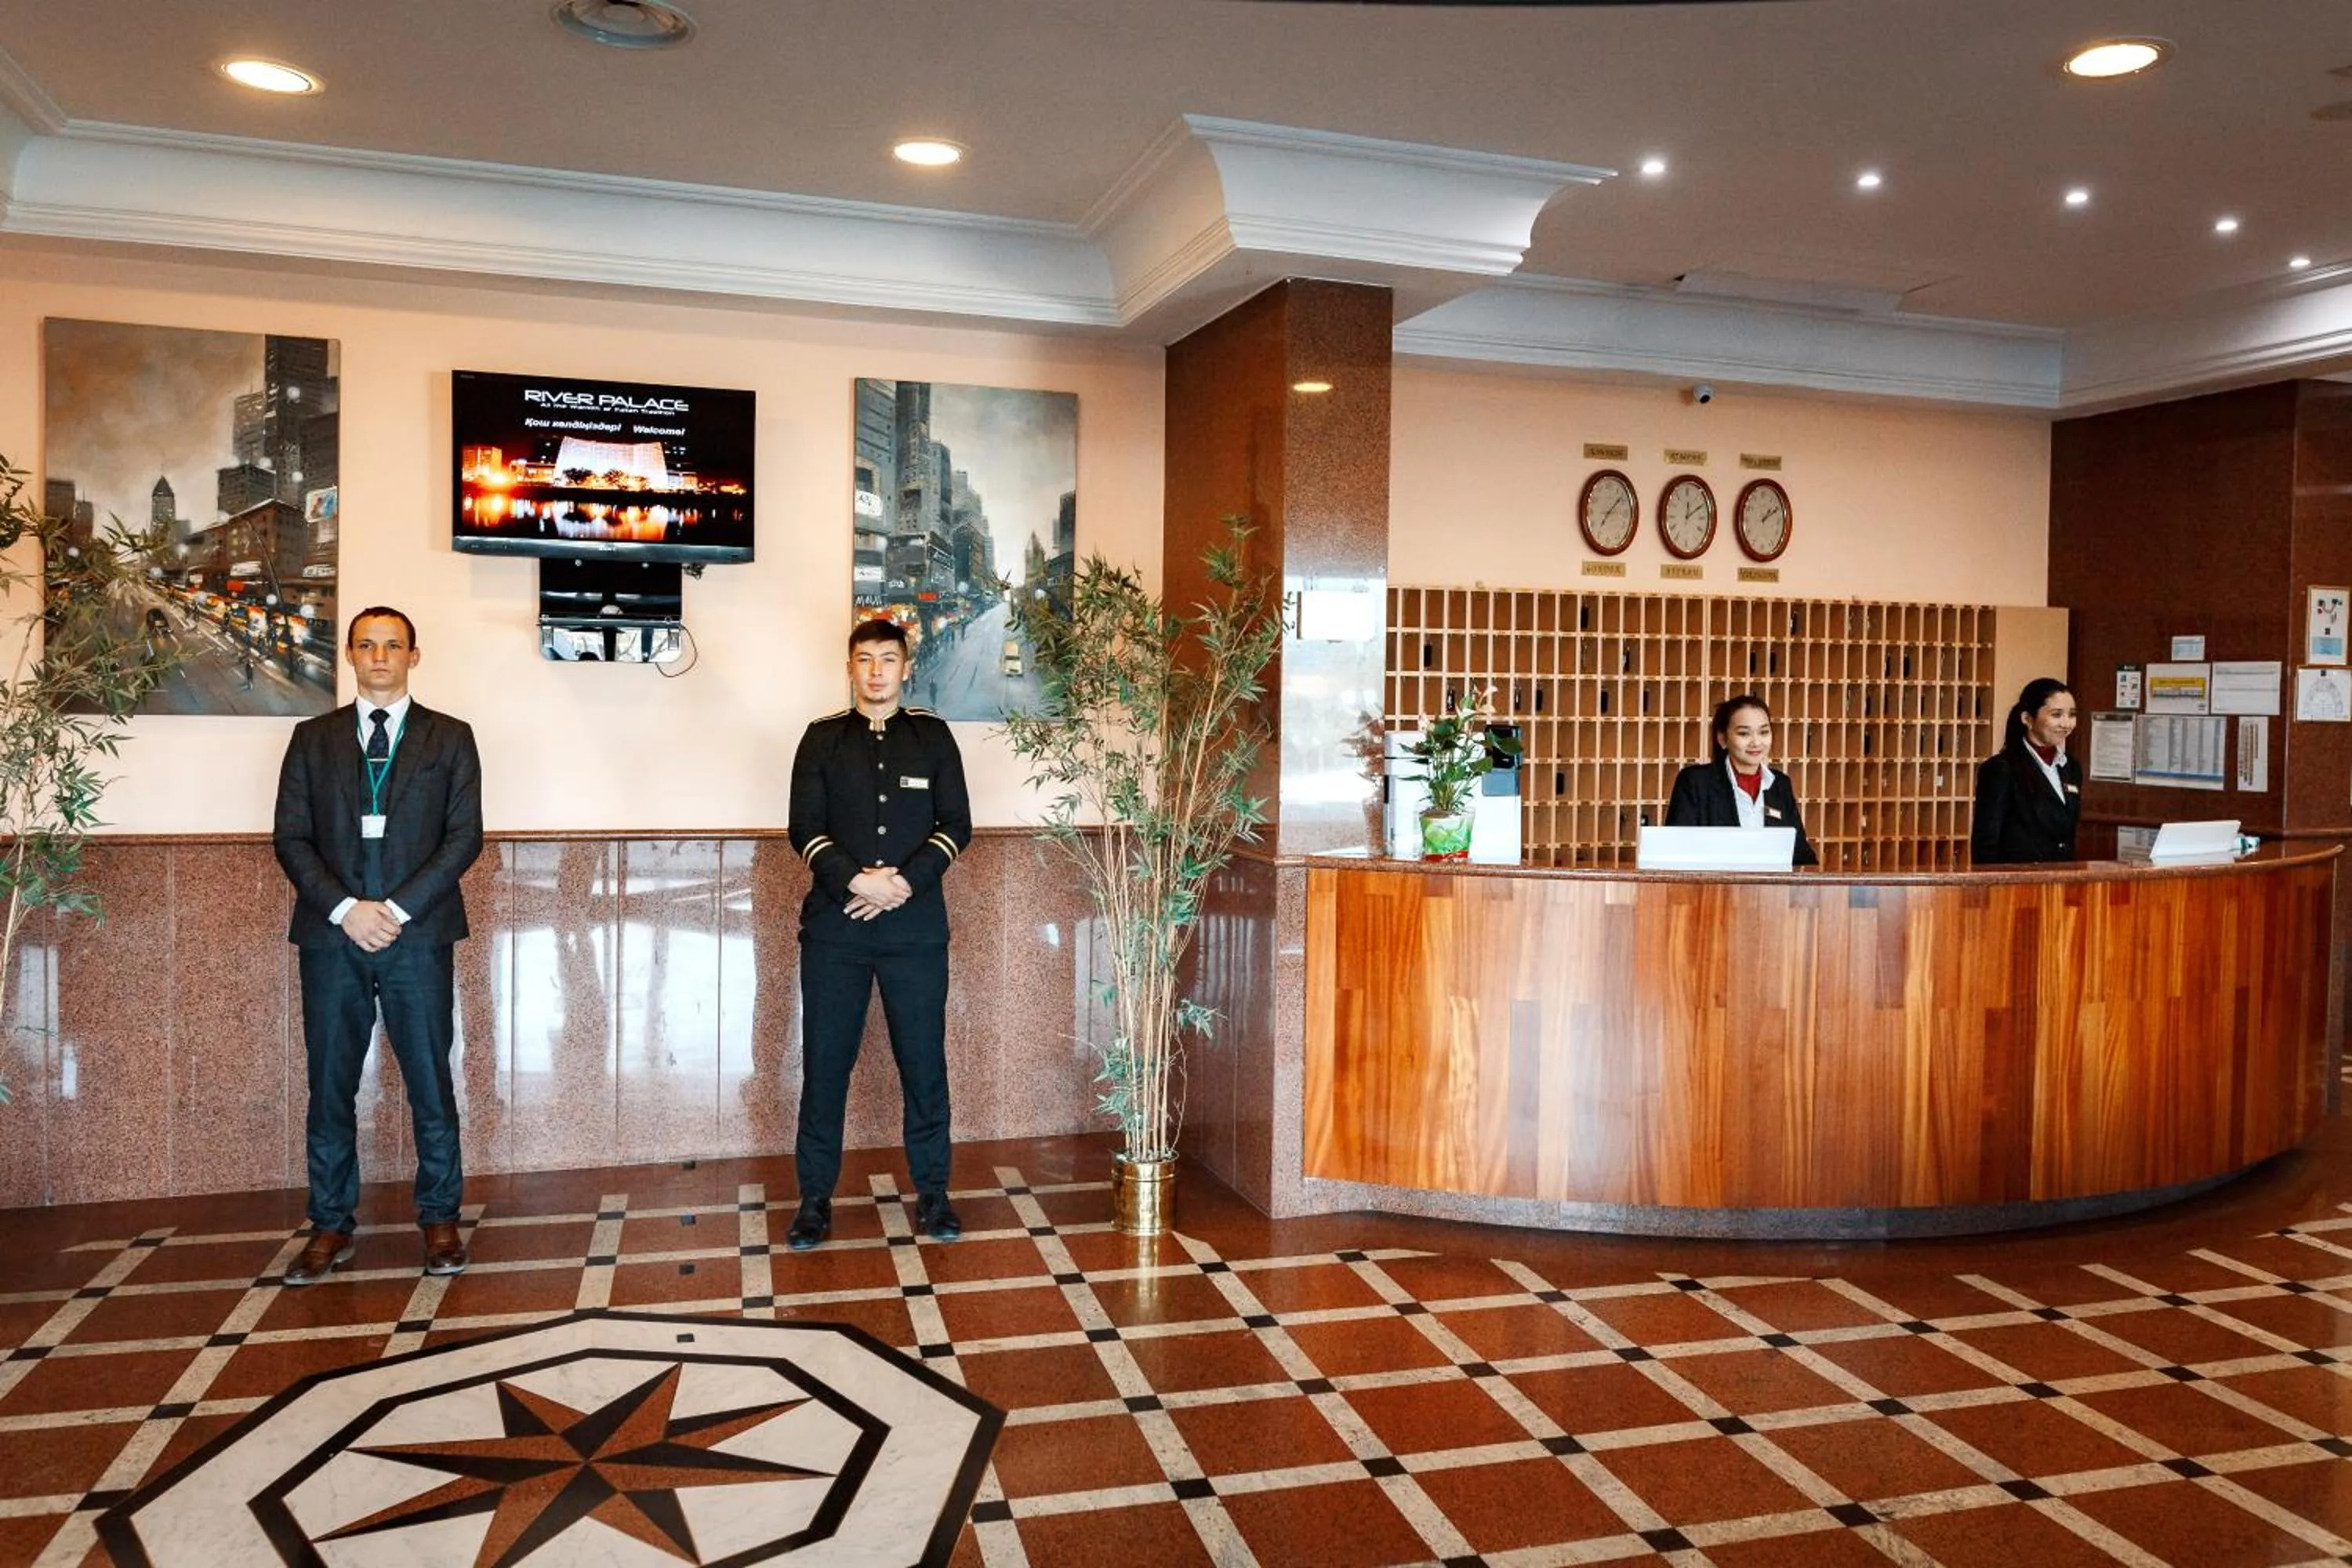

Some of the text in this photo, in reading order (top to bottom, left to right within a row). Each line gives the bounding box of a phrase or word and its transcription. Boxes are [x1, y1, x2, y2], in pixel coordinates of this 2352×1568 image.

[524, 390, 689, 412] RIVER PALACE
[633, 424, 686, 437] Welcome!
